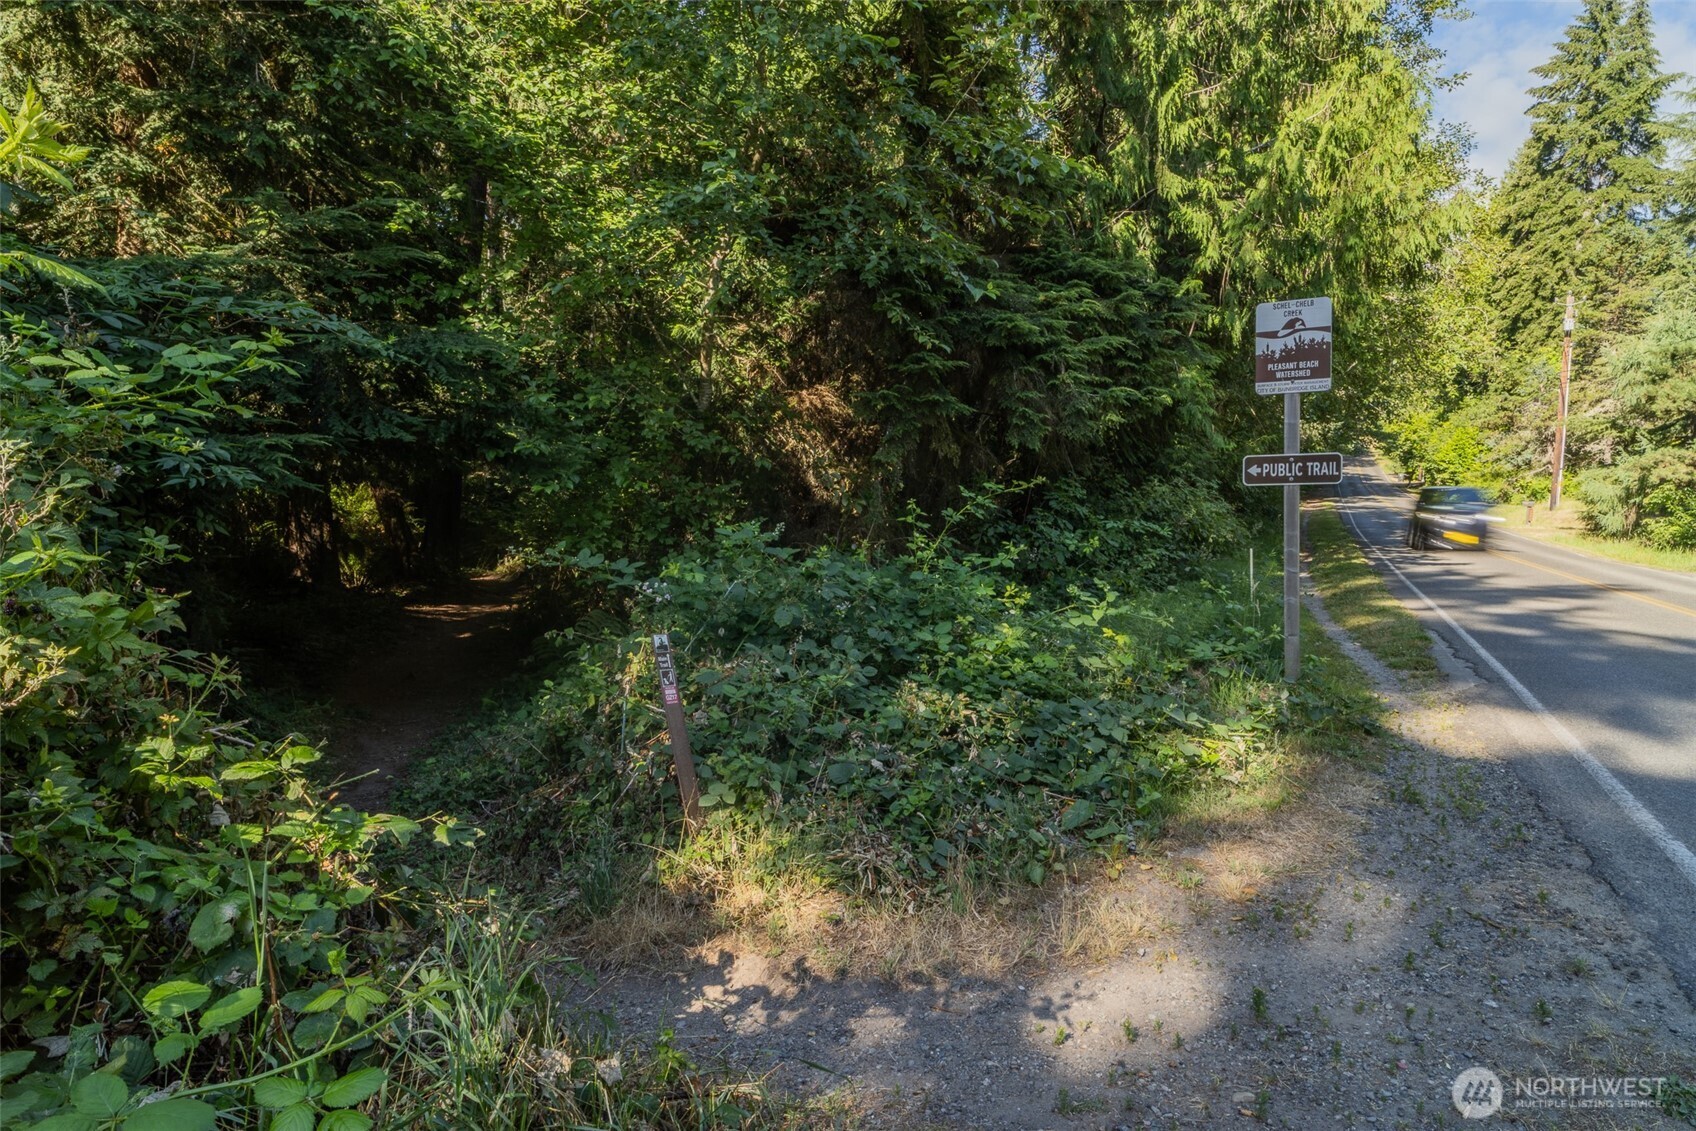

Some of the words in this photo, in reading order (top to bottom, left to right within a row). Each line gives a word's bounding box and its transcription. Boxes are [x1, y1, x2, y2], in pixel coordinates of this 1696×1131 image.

[1267, 362, 1298, 371] PLEASANT
[1299, 360, 1319, 368] BEACH
[1276, 370, 1311, 378] WATERSHED
[1310, 383, 1329, 391] ISLAND
[1262, 462, 1303, 477] PUBLIC
[1306, 461, 1339, 476] TRAIL
